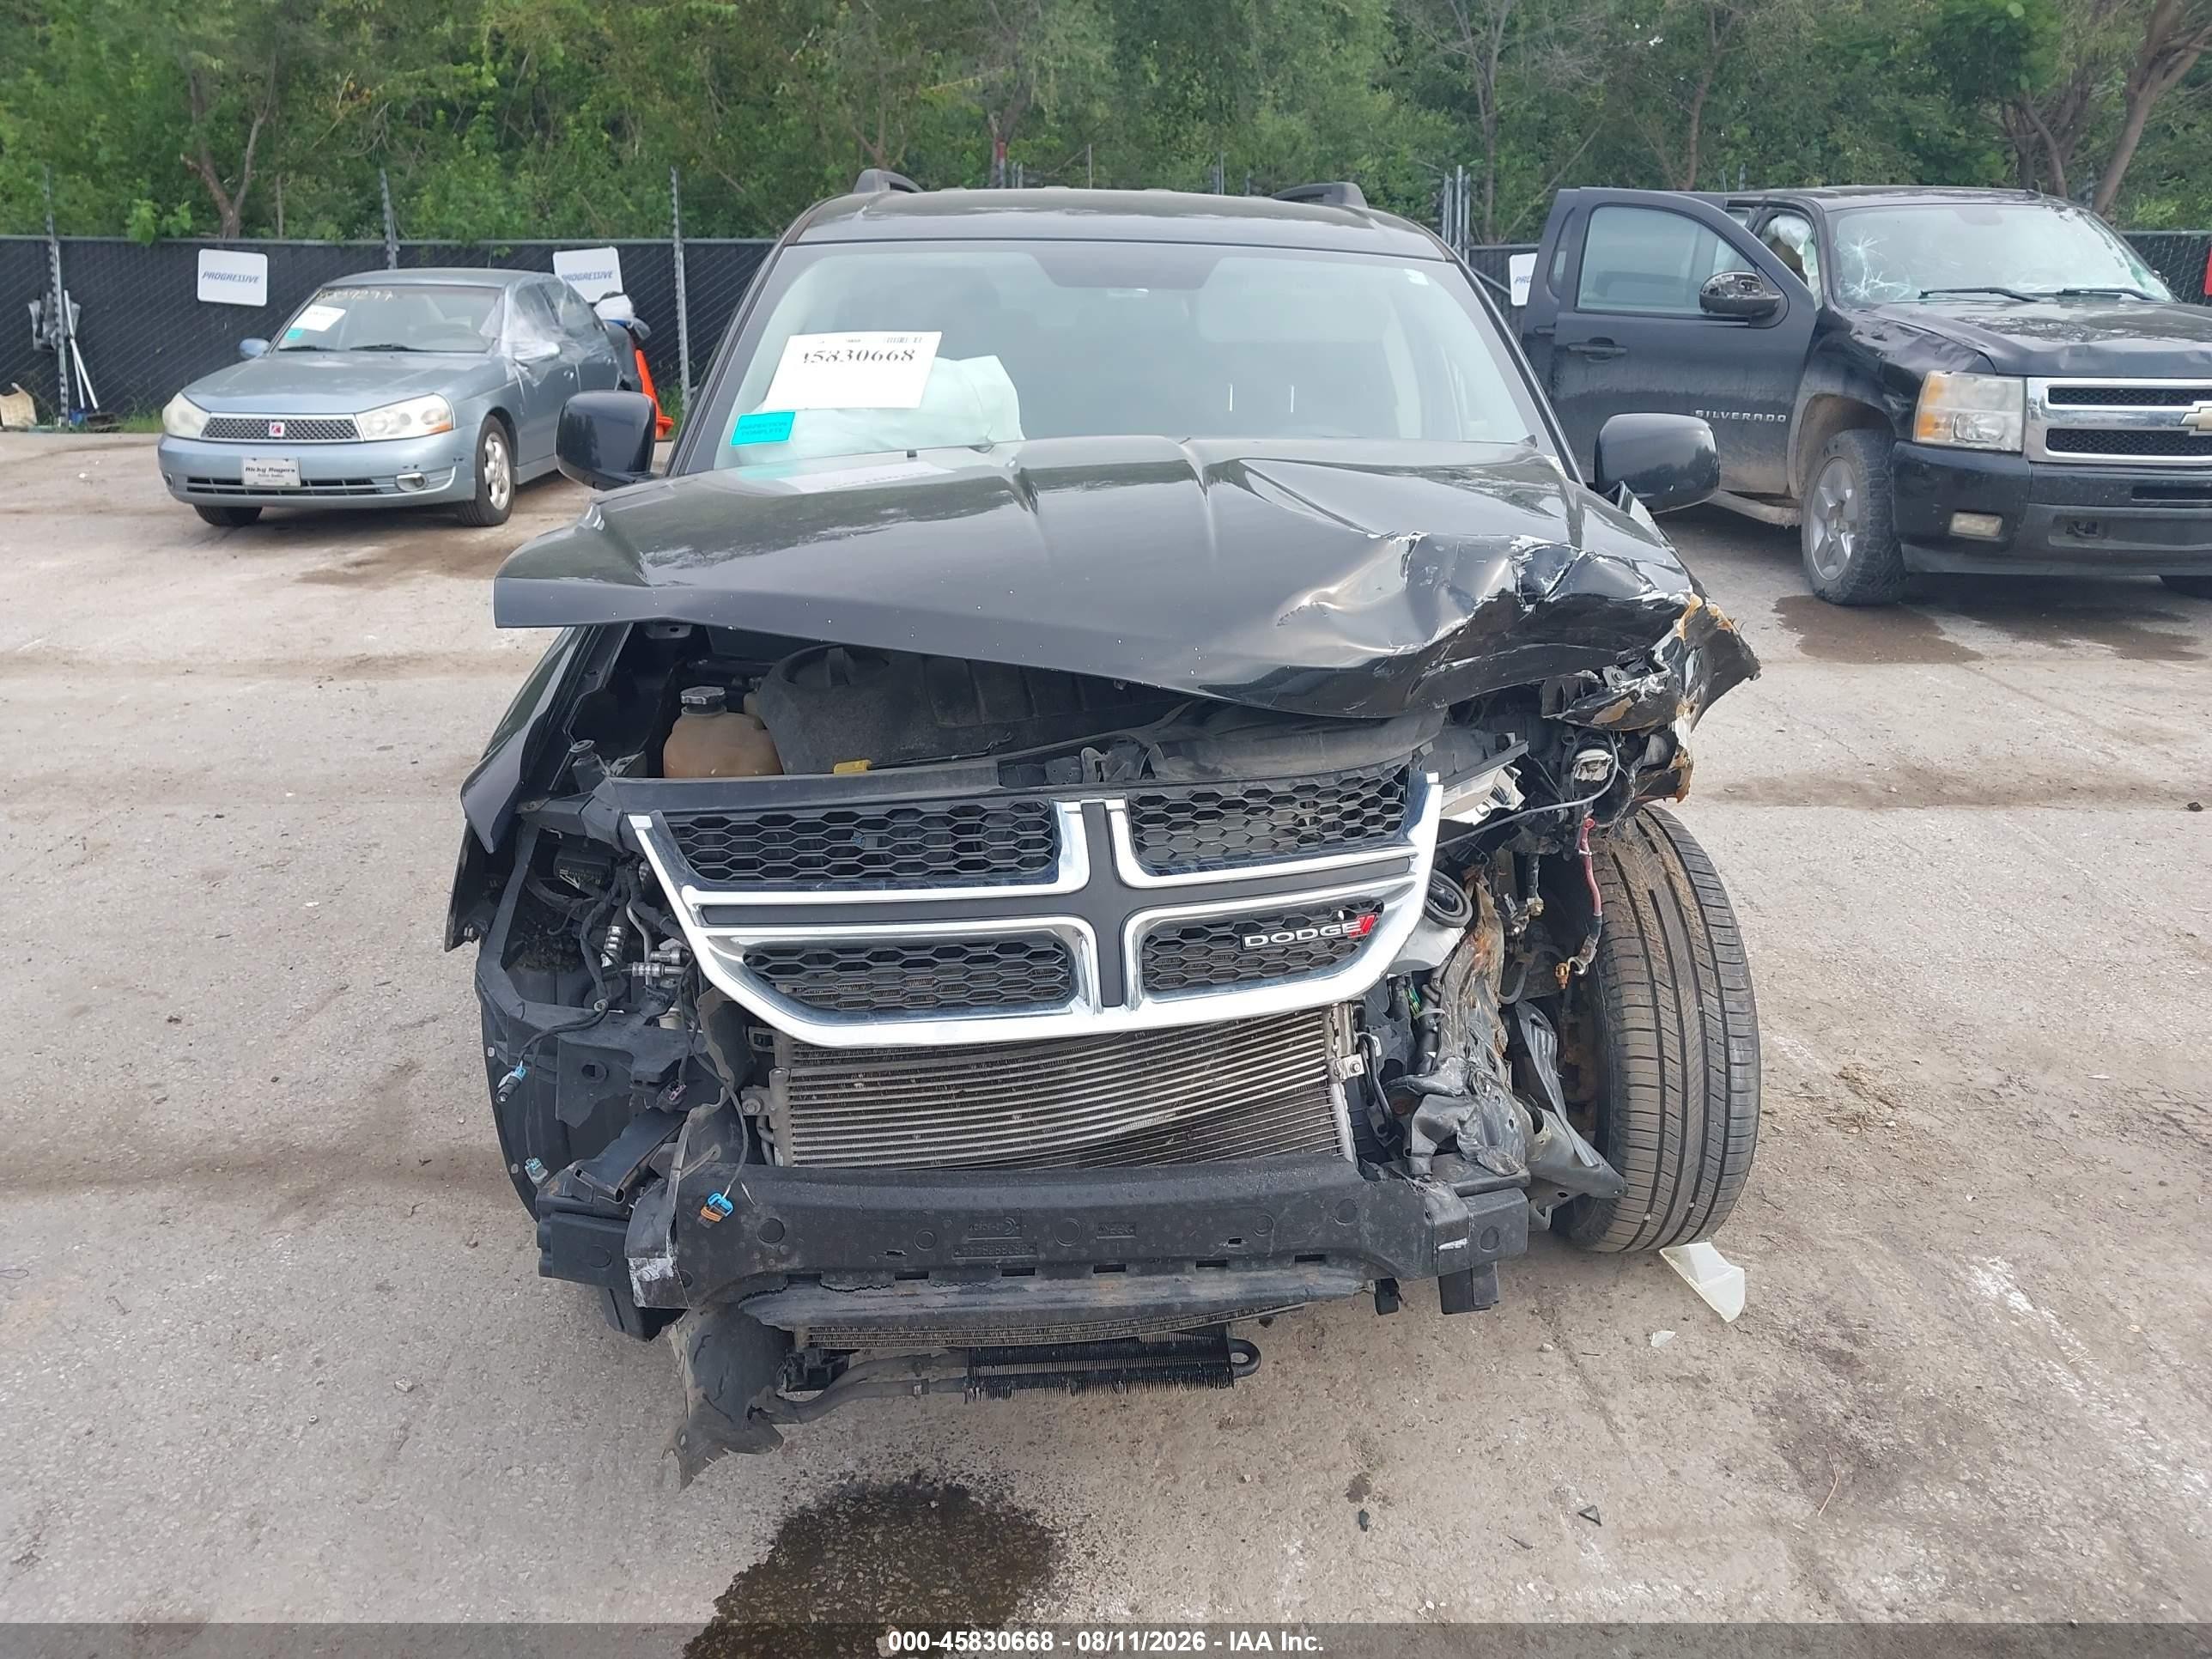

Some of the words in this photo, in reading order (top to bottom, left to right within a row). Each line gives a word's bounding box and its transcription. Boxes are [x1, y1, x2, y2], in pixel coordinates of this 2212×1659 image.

[202, 270, 259, 283] PROGRESSIVE
[1694, 410, 1787, 422] SILVERADO
[1244, 921, 1361, 947] DODGE
